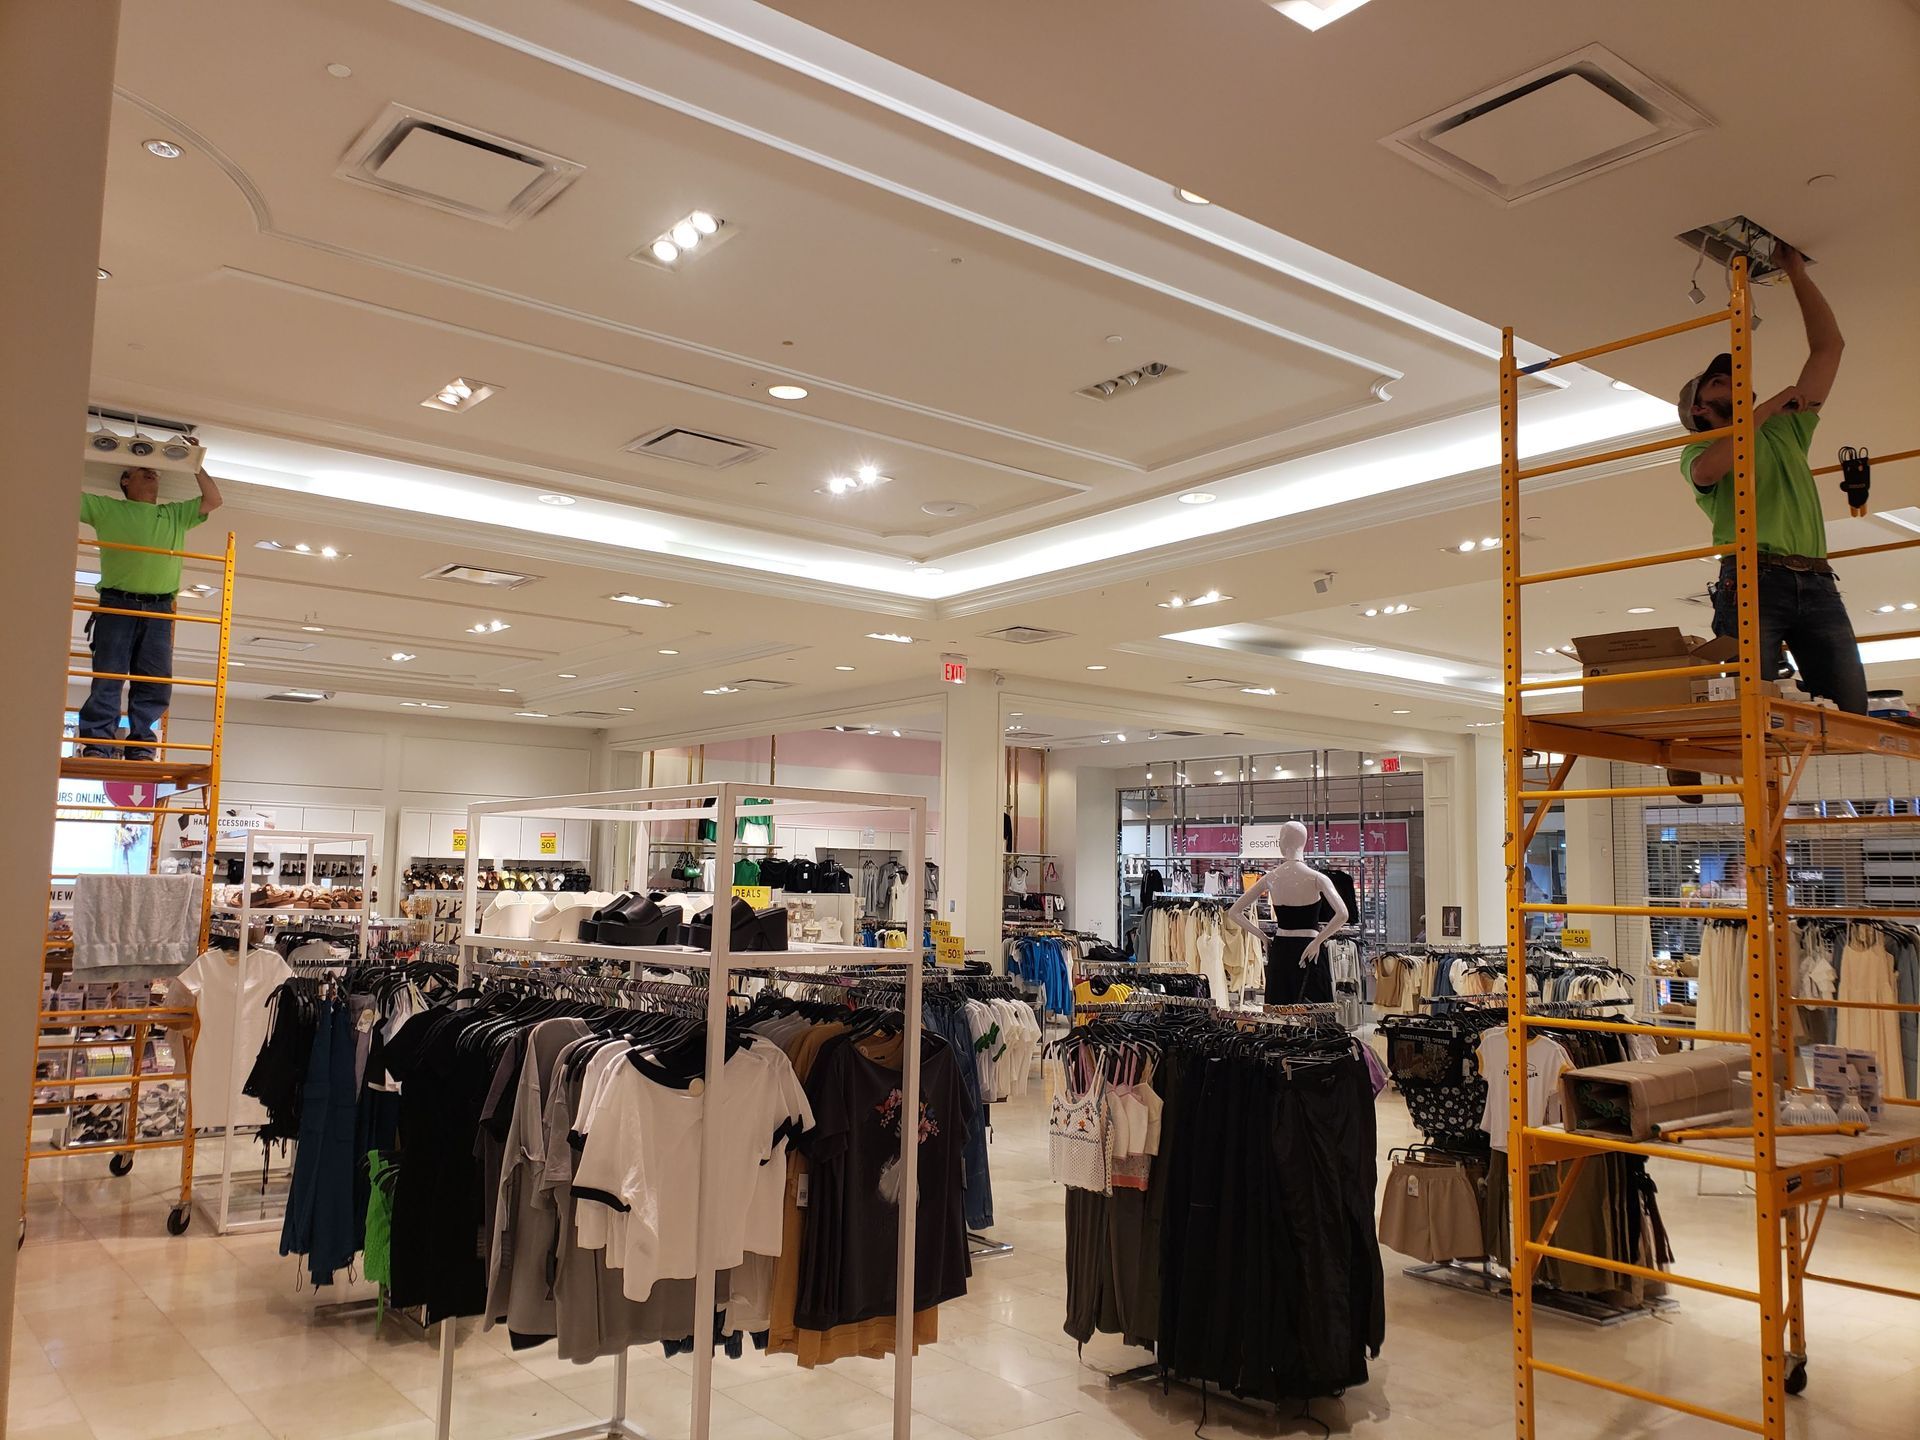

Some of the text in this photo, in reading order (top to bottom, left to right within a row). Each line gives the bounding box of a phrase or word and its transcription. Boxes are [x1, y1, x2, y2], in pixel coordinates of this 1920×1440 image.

[945, 663, 963, 680] EXIT
[76, 792, 107, 804] ONLINE
[217, 818, 260, 828] CCESSORIES
[49, 890, 73, 901] NEW
[735, 888, 761, 898] DEALS
